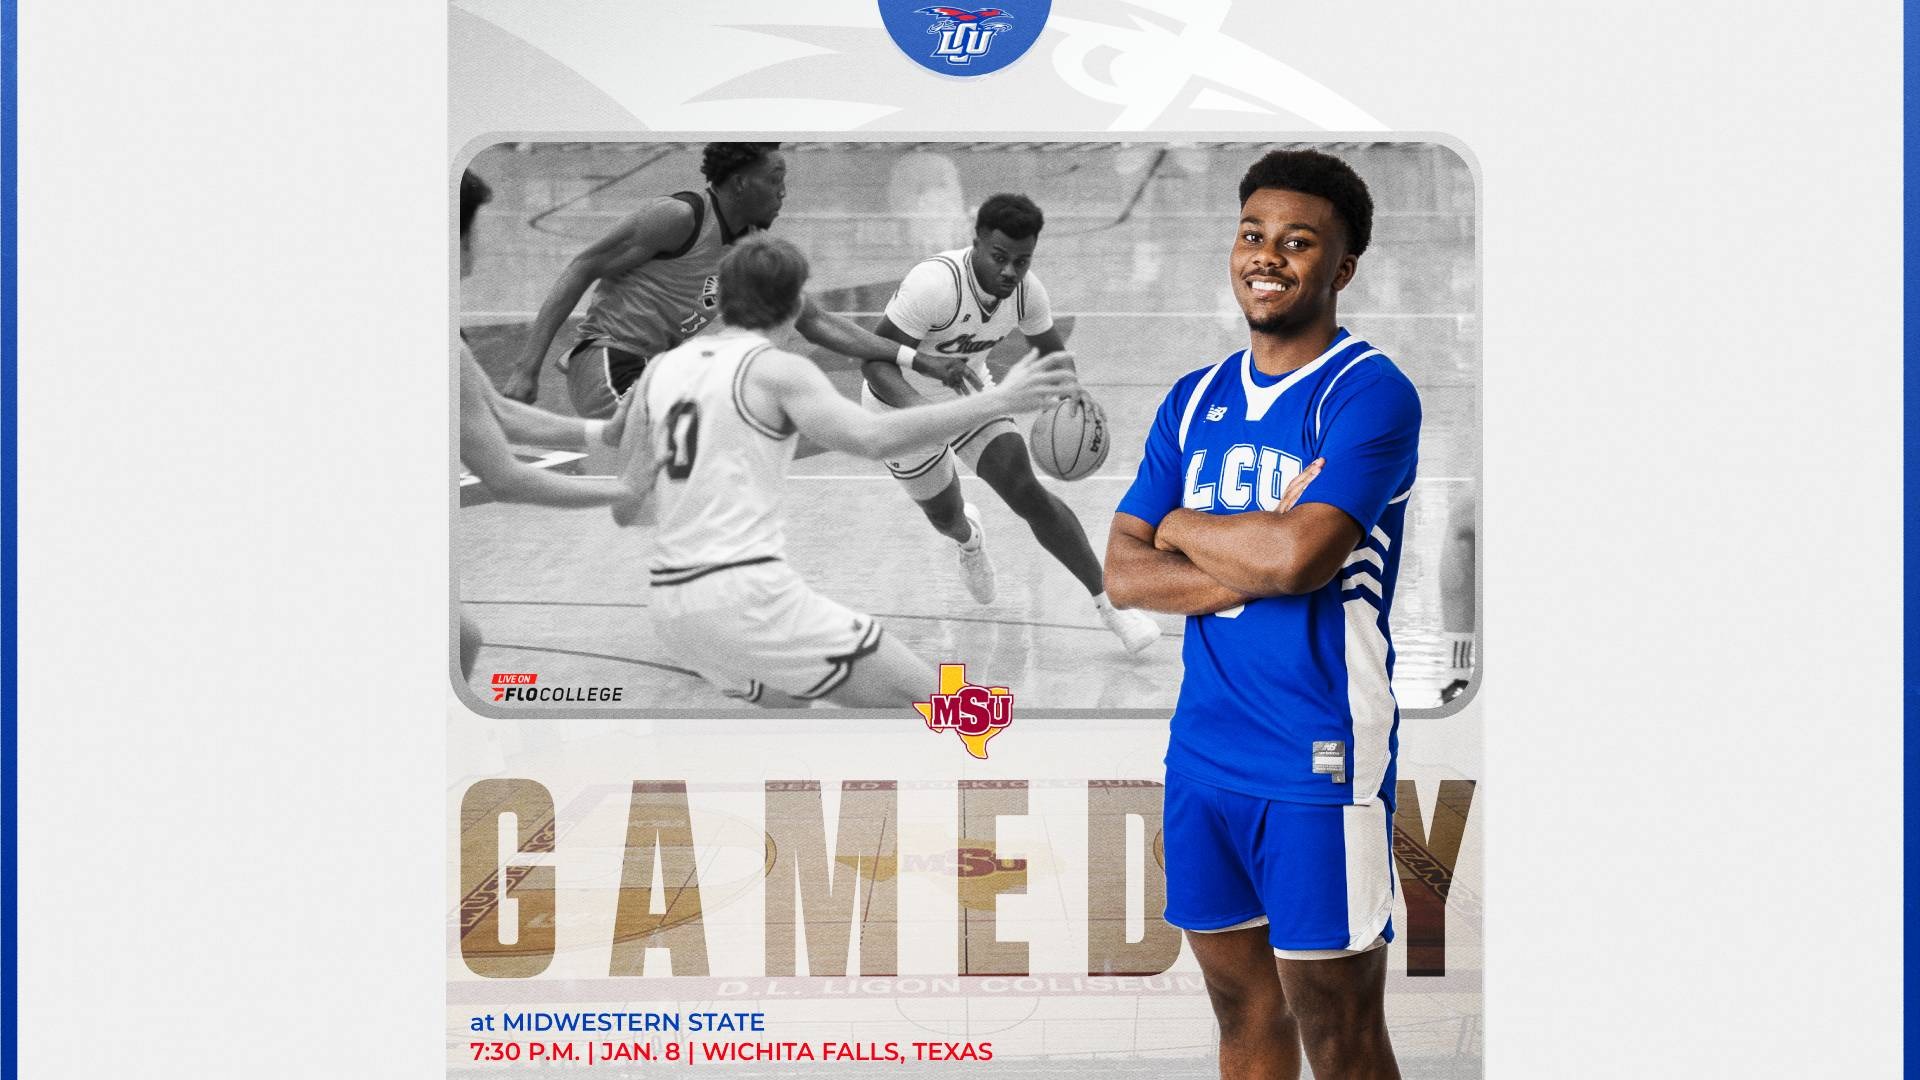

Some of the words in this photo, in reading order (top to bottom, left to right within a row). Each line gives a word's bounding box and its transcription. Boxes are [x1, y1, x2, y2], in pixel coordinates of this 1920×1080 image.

[667, 400, 699, 480] 0
[1183, 443, 1304, 512] LCU
[823, 979, 961, 995] LIGON
